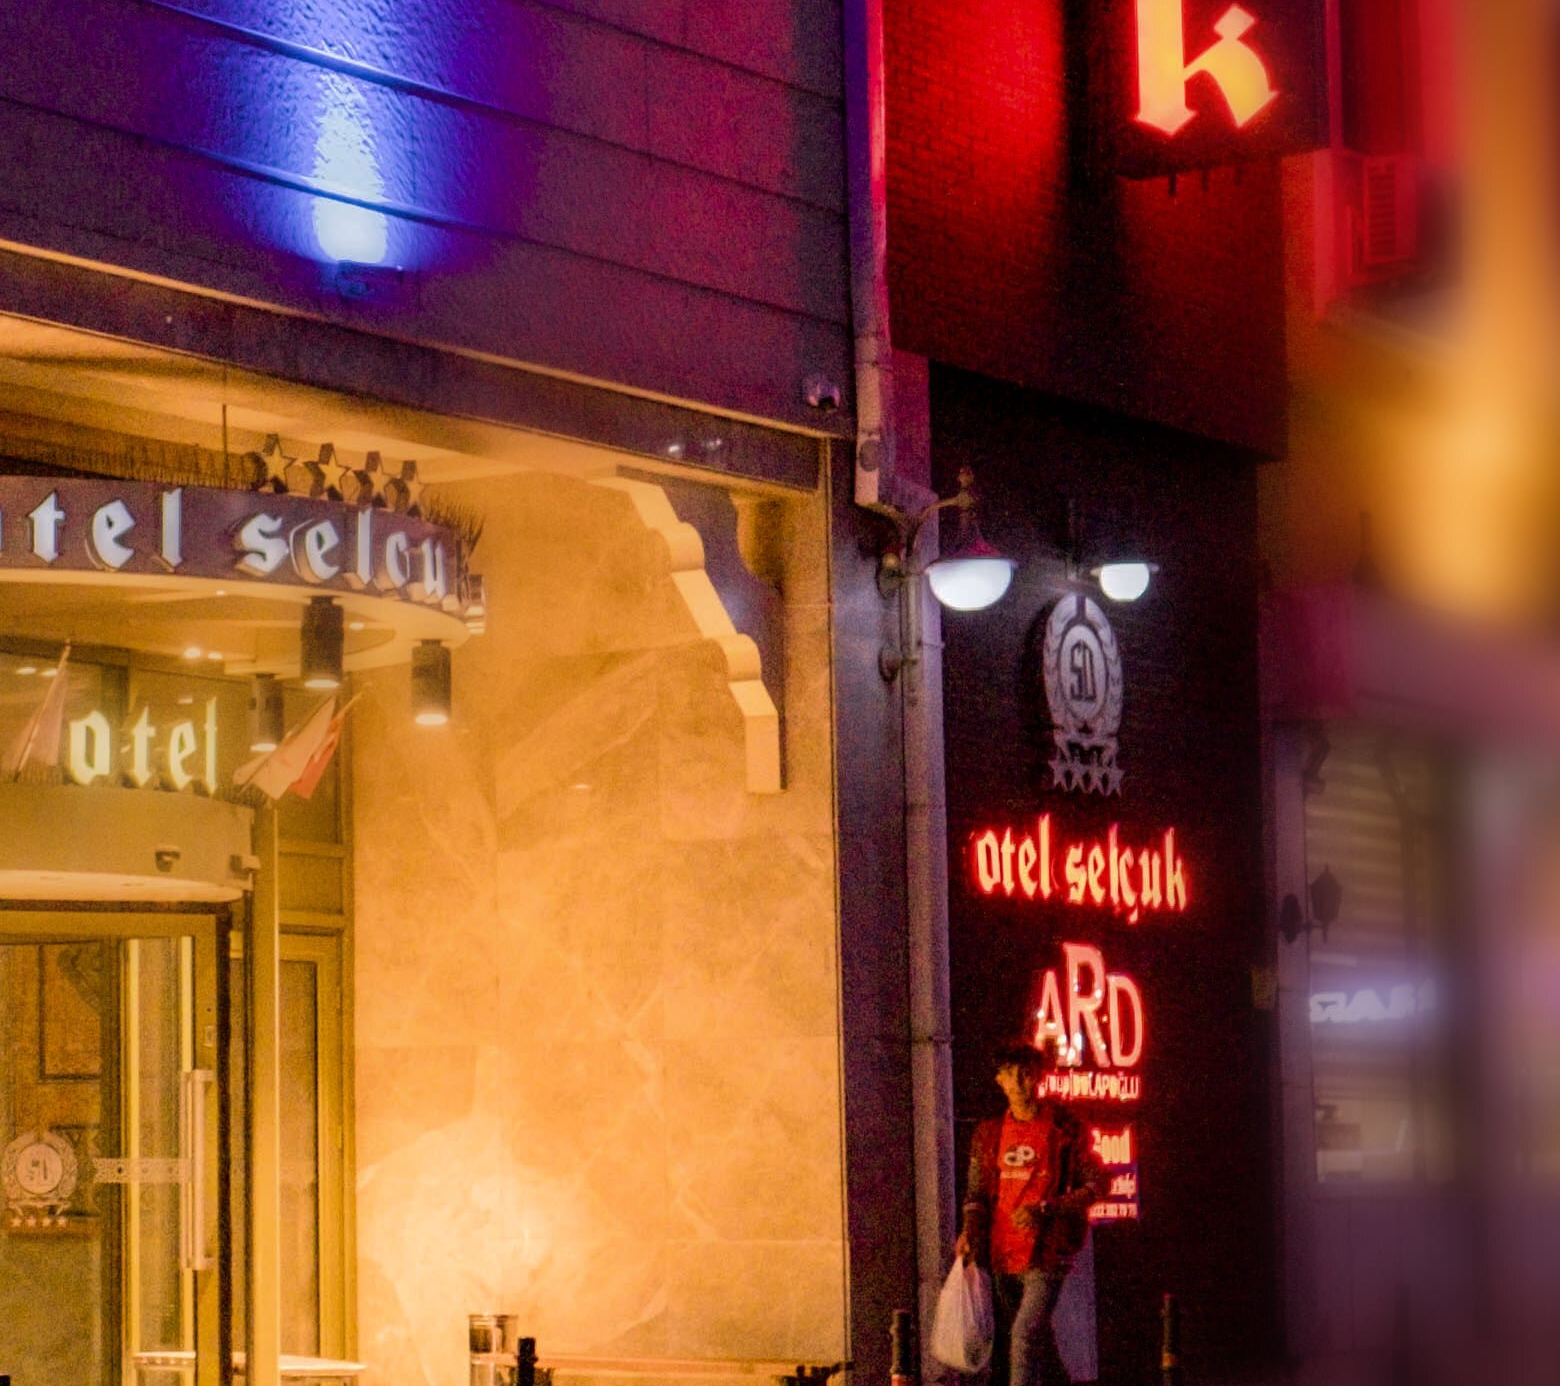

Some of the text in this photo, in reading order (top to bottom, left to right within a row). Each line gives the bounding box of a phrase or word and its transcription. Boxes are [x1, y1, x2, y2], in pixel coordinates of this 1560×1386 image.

[68, 695, 218, 798] otel
[976, 813, 1187, 924] otel selçuk
[1033, 941, 1143, 1068] ARD
